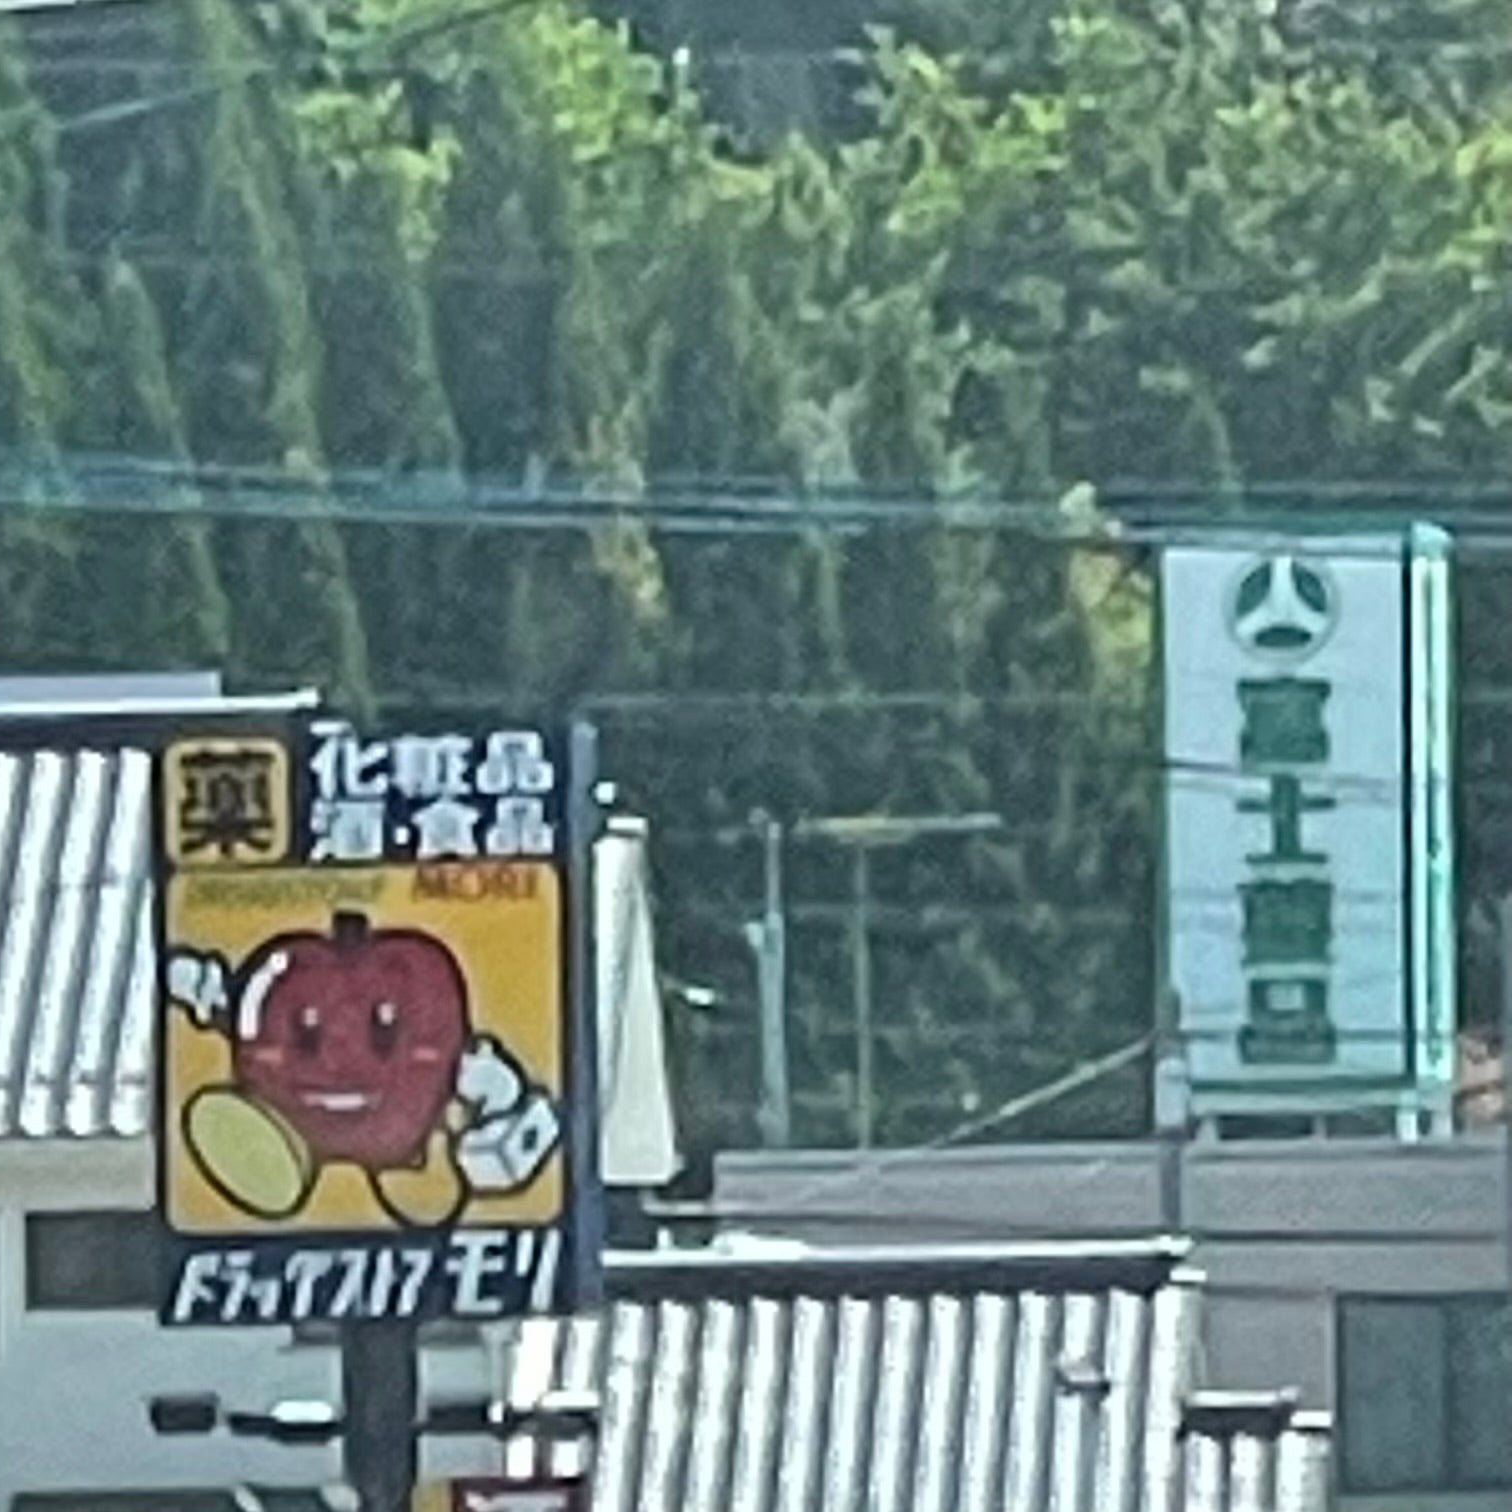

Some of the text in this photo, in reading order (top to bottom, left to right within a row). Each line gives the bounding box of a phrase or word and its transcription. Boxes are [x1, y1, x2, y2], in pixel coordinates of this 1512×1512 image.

[310, 721, 555, 797] 化粧品
[180, 752, 276, 858] 薬
